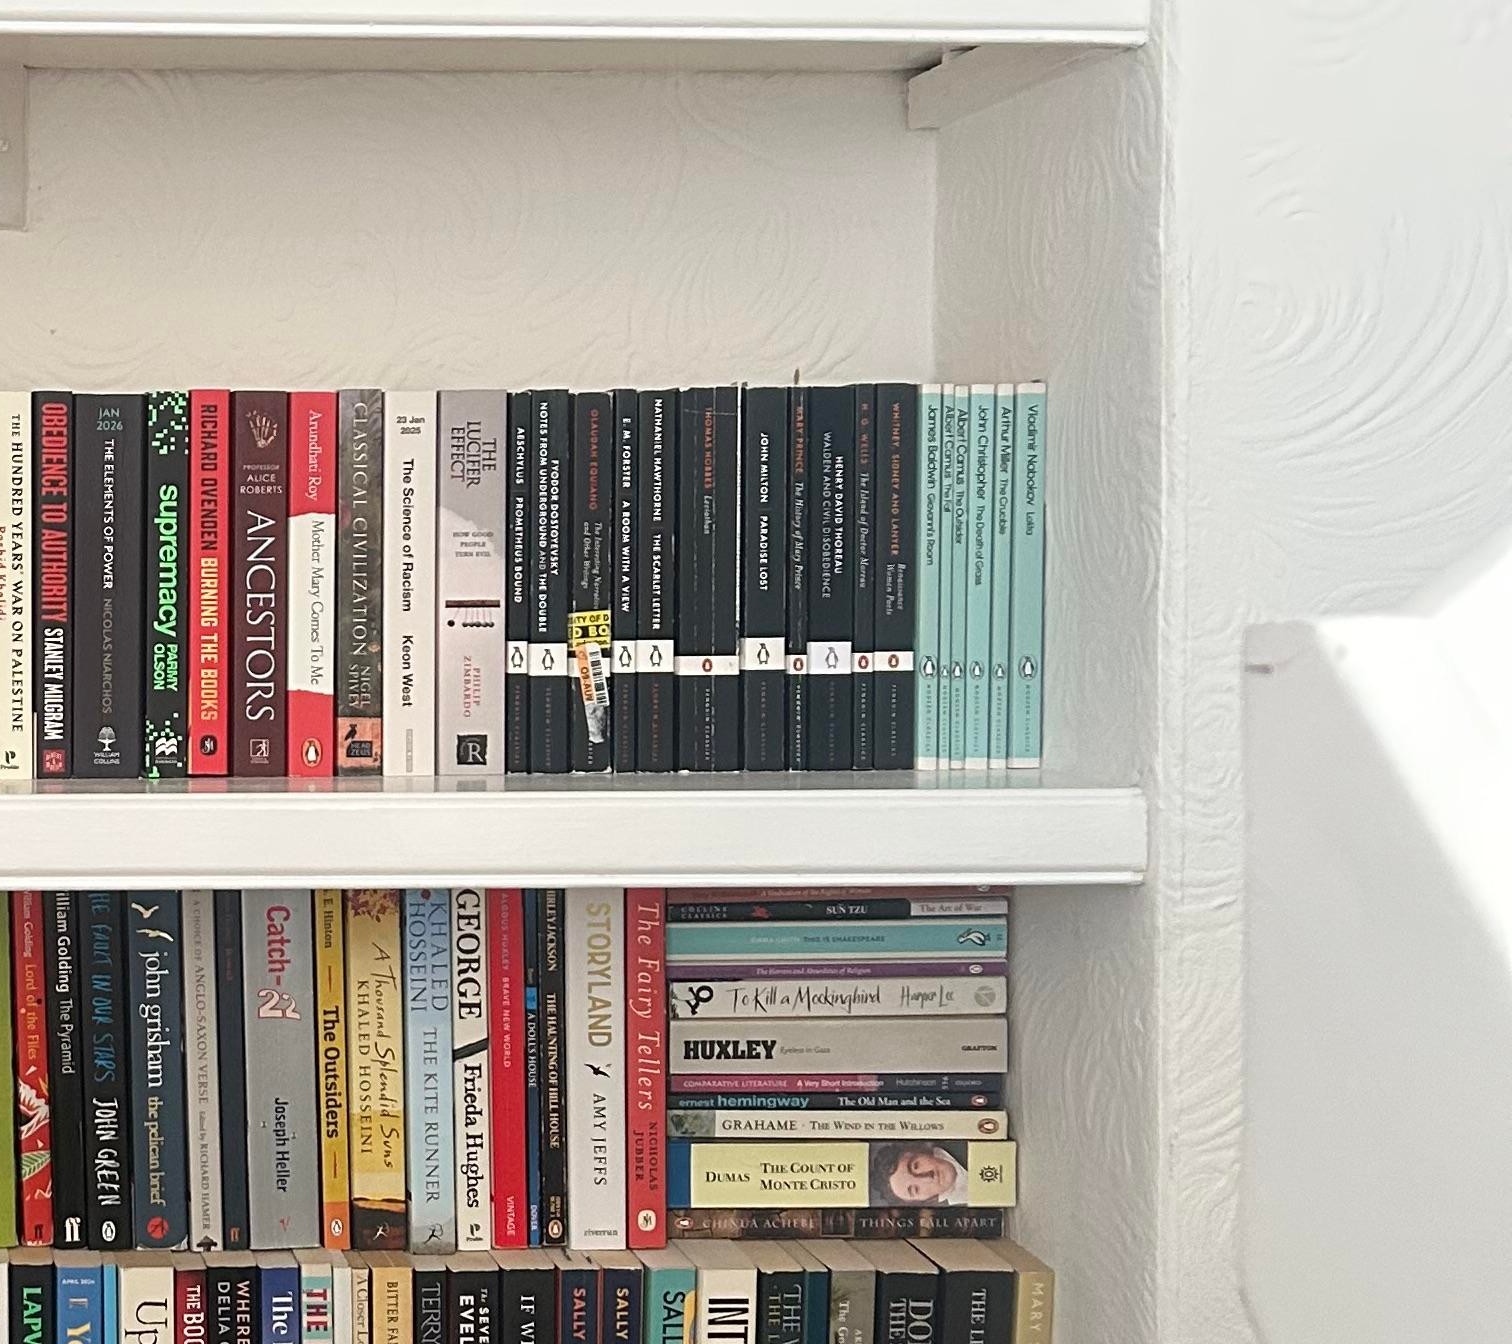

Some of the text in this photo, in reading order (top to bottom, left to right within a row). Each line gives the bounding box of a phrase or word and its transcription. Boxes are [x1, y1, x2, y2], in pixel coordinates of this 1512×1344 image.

[12, 414, 21, 437] THE
[12, 442, 23, 516] HUNDRED
[42, 403, 67, 621] OBEDIENCE TO AUTHORITY
[155, 484, 180, 637] supremacy
[402, 459, 414, 611] The Science of Racism
[12, 581, 24, 616] WAR
[12, 621, 23, 642] ON
[201, 558, 218, 720] BURNING THE BOOKS
[246, 511, 275, 721] ANCESTORS
[12, 649, 24, 732] PALESTINE
[142, 951, 168, 1088] john grisham
[457, 889, 481, 1020] GEORGE
[587, 903, 612, 1047] STORYLAND
[630, 903, 659, 1110] The Fairy Tellers
[323, 1006, 341, 1138] The Outsiders
[683, 1040, 776, 1060] HUXLEY
[462, 1064, 483, 1208] Frieda Hughes
[705, 1172, 750, 1184] DUMAS
[760, 1162, 855, 1173] THE COUNT OF
[760, 1179, 856, 1190] MONTE CRISTO
[306, 1289, 328, 1337] THE
